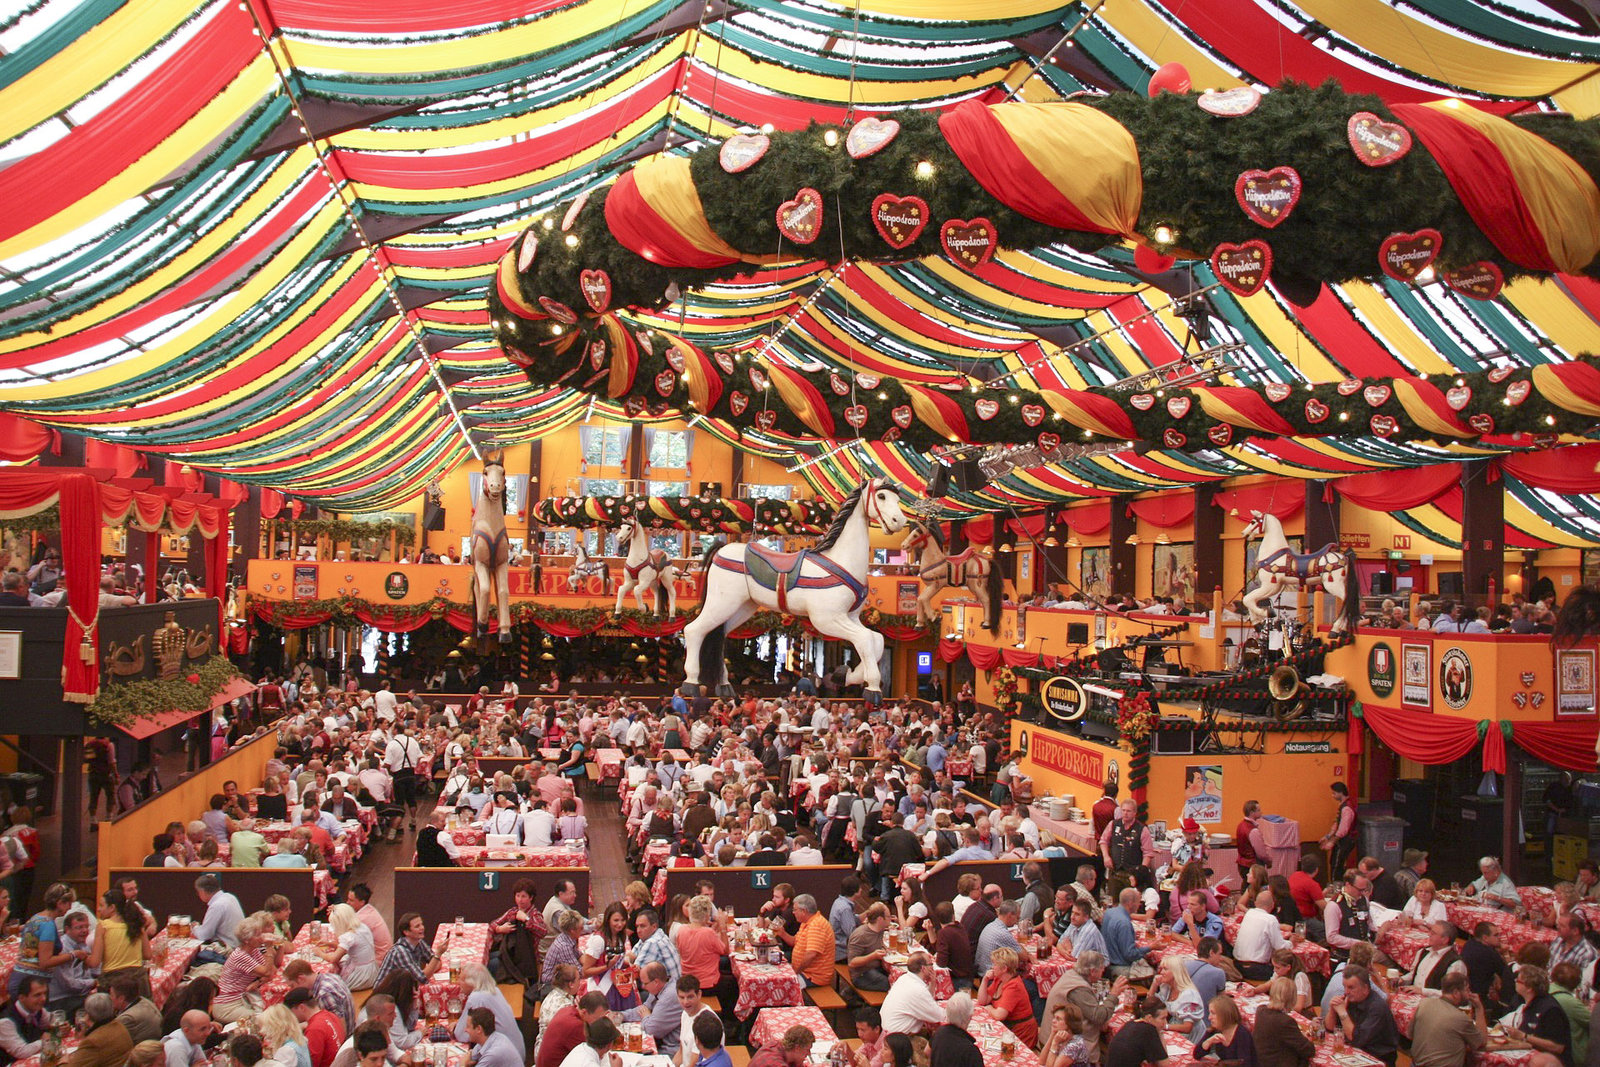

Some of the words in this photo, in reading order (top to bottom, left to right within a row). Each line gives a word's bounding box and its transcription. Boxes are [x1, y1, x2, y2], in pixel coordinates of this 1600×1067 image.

[1355, 124, 1400, 151] Hippodrom
[1244, 189, 1291, 207] Hippodrom
[783, 202, 816, 229] Hippodrom
[878, 210, 920, 227] Hippodrom
[947, 237, 989, 251] Hippodrom
[1387, 250, 1431, 264] Hippodrom
[1218, 259, 1261, 278] Hippodrom
[1395, 536, 1409, 548] N1
[1371, 679, 1392, 688] SPATEN
[1286, 743, 1329, 752] Notausgang
[1203, 810, 1218, 818] NO!
[484, 872, 495, 889] J
[756, 873, 767, 886] K
